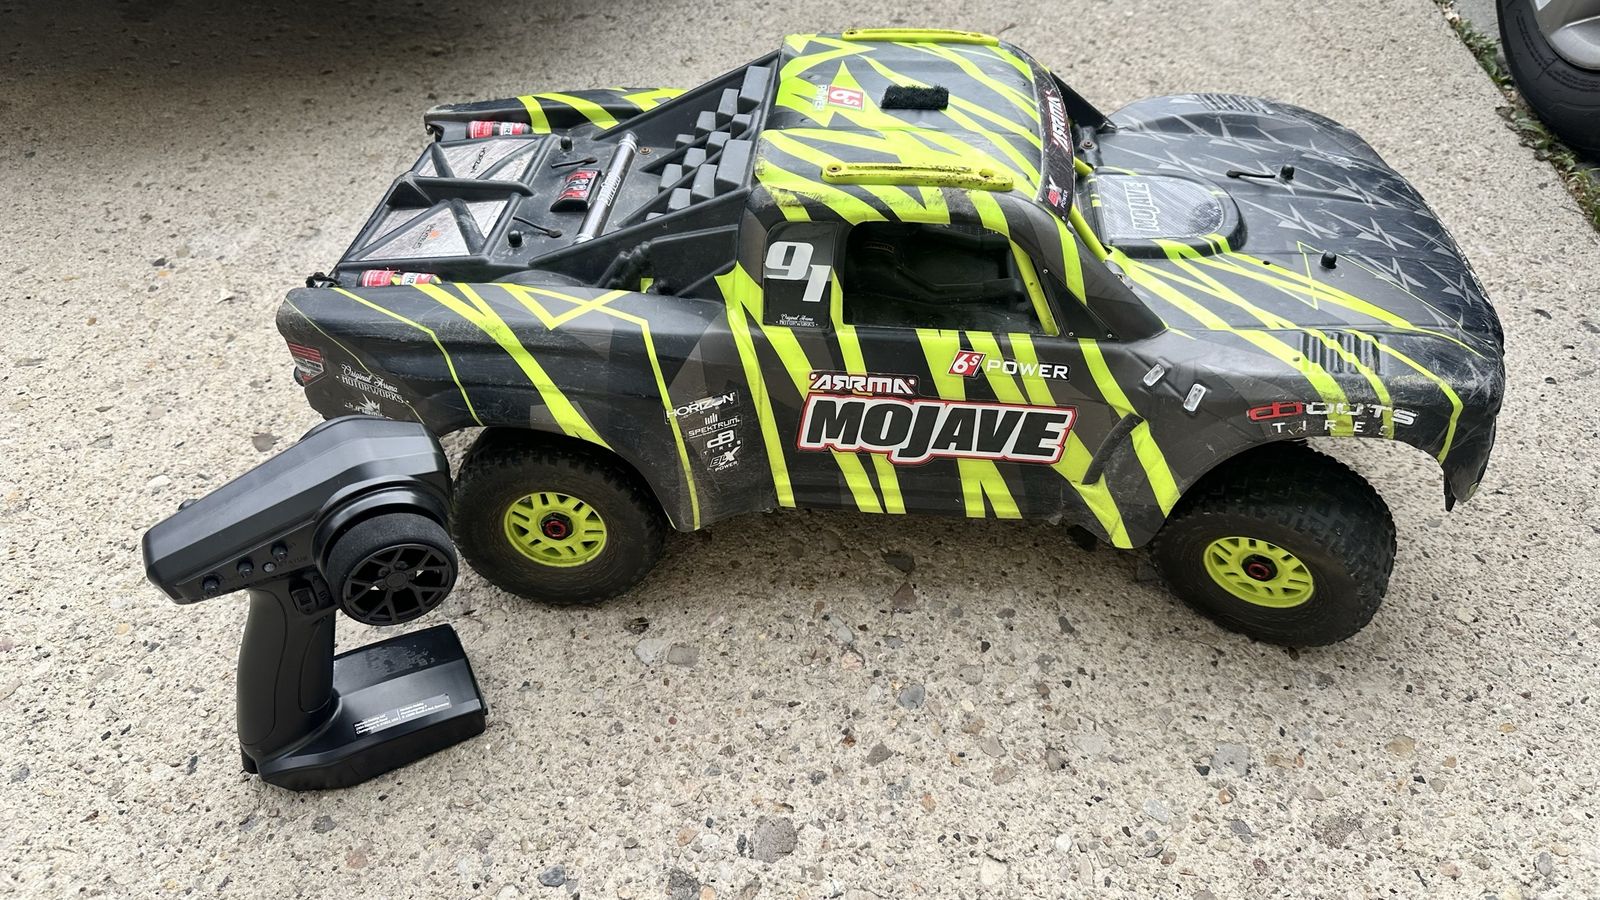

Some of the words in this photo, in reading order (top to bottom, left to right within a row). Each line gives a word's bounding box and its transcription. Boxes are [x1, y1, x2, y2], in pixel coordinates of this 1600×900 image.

[1123, 181, 1160, 231] MOJAVE
[765, 241, 831, 302] 91
[986, 360, 1069, 380] POWER
[688, 417, 738, 436] SPEKTRUM
[802, 397, 1072, 461] MOJAVE
